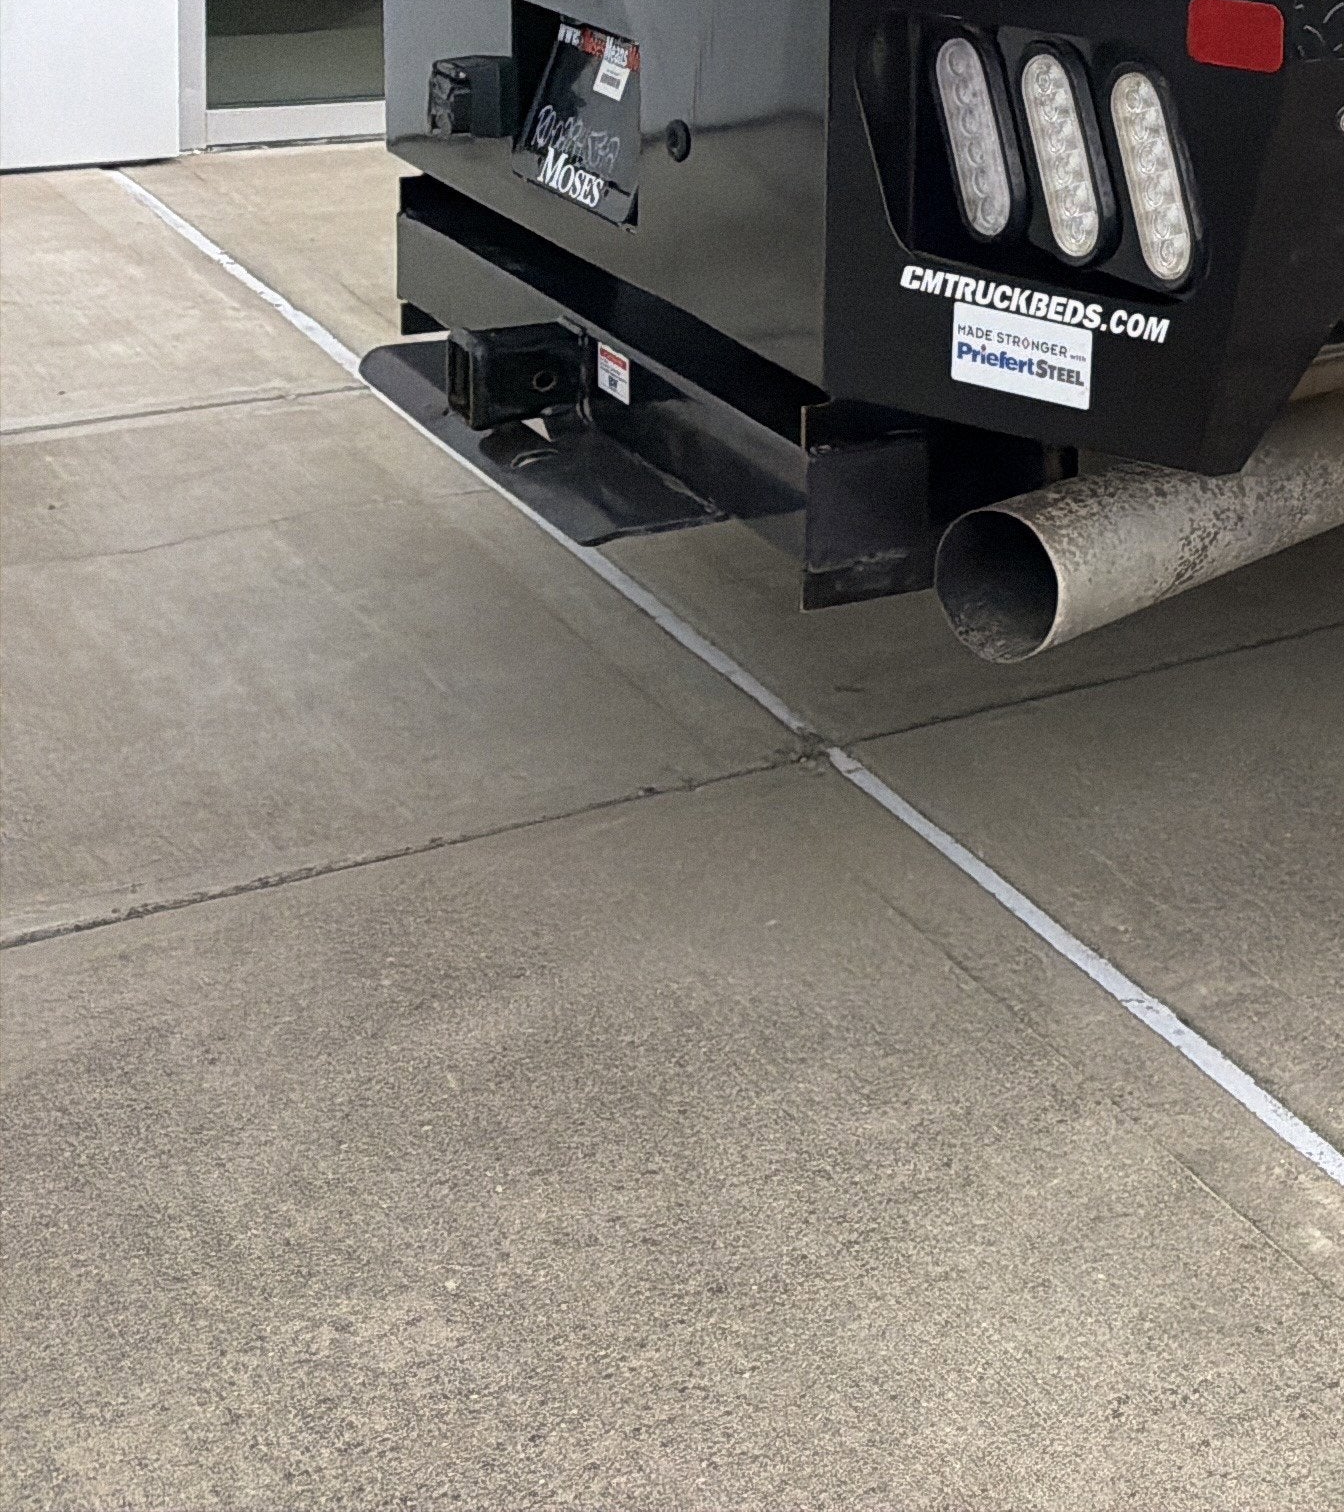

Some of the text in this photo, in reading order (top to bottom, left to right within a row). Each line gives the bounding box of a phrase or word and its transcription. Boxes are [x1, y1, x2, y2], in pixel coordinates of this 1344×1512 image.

[536, 145, 604, 208] MOSES
[900, 265, 1171, 344] CMTRUCKBEDS.COM
[957, 323, 993, 343] MADE
[996, 331, 1068, 359] STRONGER
